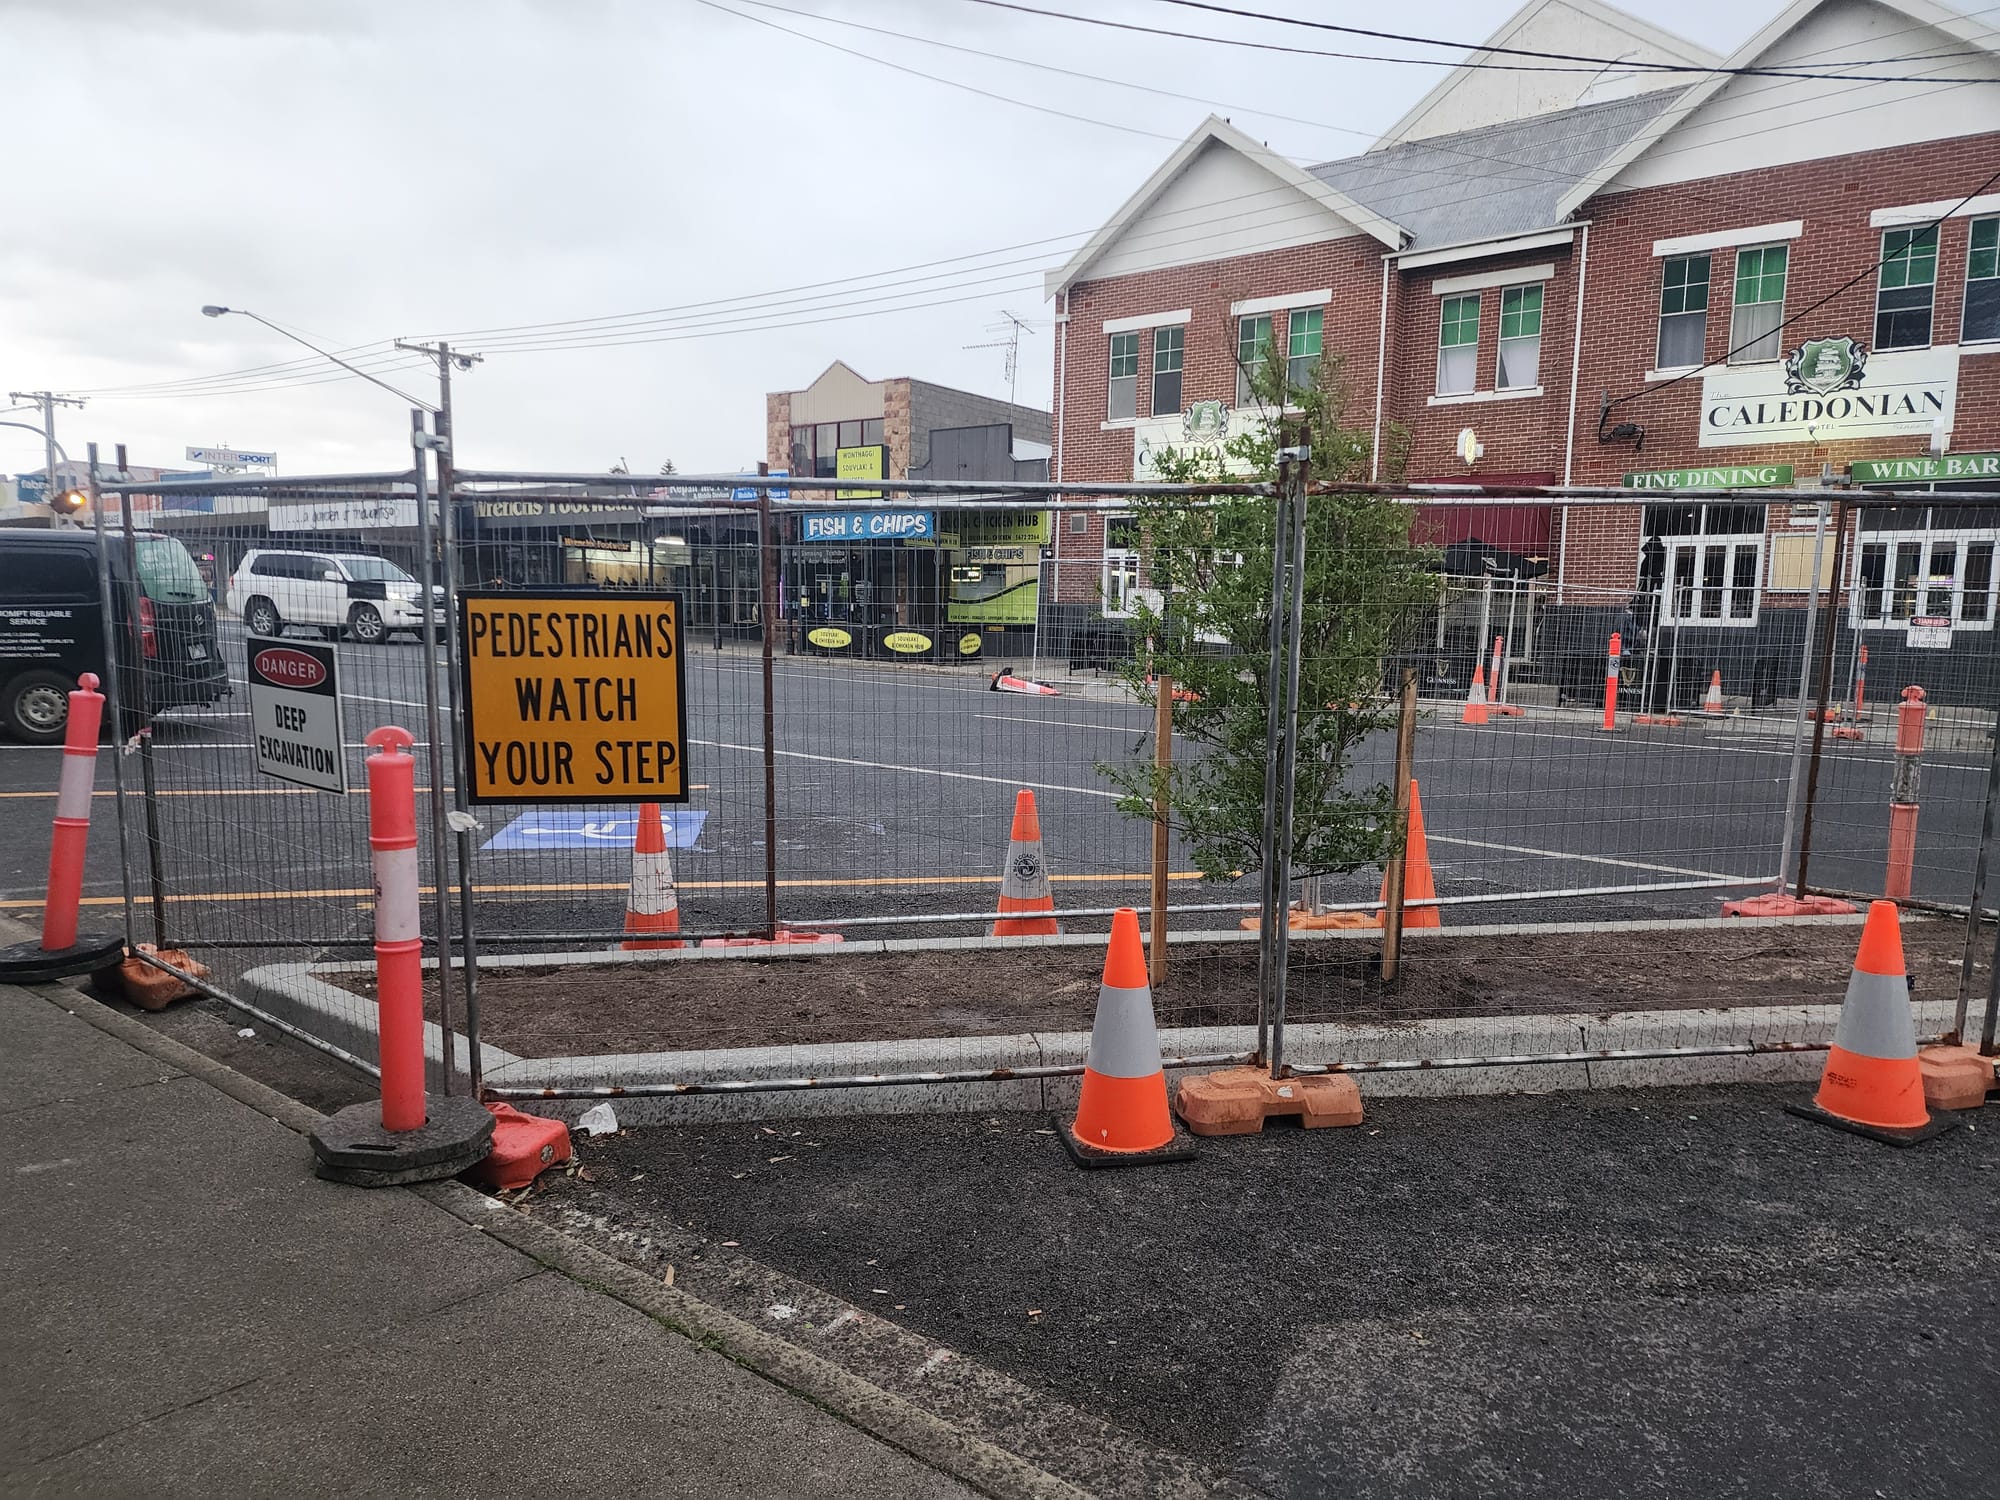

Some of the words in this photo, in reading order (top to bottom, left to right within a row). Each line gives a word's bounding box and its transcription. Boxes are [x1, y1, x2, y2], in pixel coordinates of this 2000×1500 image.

[1708, 390, 1946, 428] CALEDONIAN
[204, 450, 272, 464] INTERSPORT
[842, 450, 875, 459] WONTHAGGI
[842, 463, 868, 471] SOUVLAKI
[1632, 473, 1680, 489] FINE
[1686, 467, 1778, 487] DINING
[1871, 460, 1939, 479] WINE
[1945, 457, 2000, 475] BAR
[808, 515, 846, 536] FISH
[852, 514, 864, 535] &
[870, 512, 927, 534] CHIPS
[1017, 515, 1039, 527] HUB
[994, 547, 1024, 560] CHIPS
[30, 610, 72, 618] RELIABLE
[470, 612, 673, 659] PEDESTRIANS
[262, 656, 318, 680] DANGER
[514, 677, 637, 722] WATCH
[275, 704, 306, 733] DEEP
[259, 734, 335, 775] EXCAVATION
[478, 740, 574, 786] YOUR
[594, 740, 677, 785] STEP
